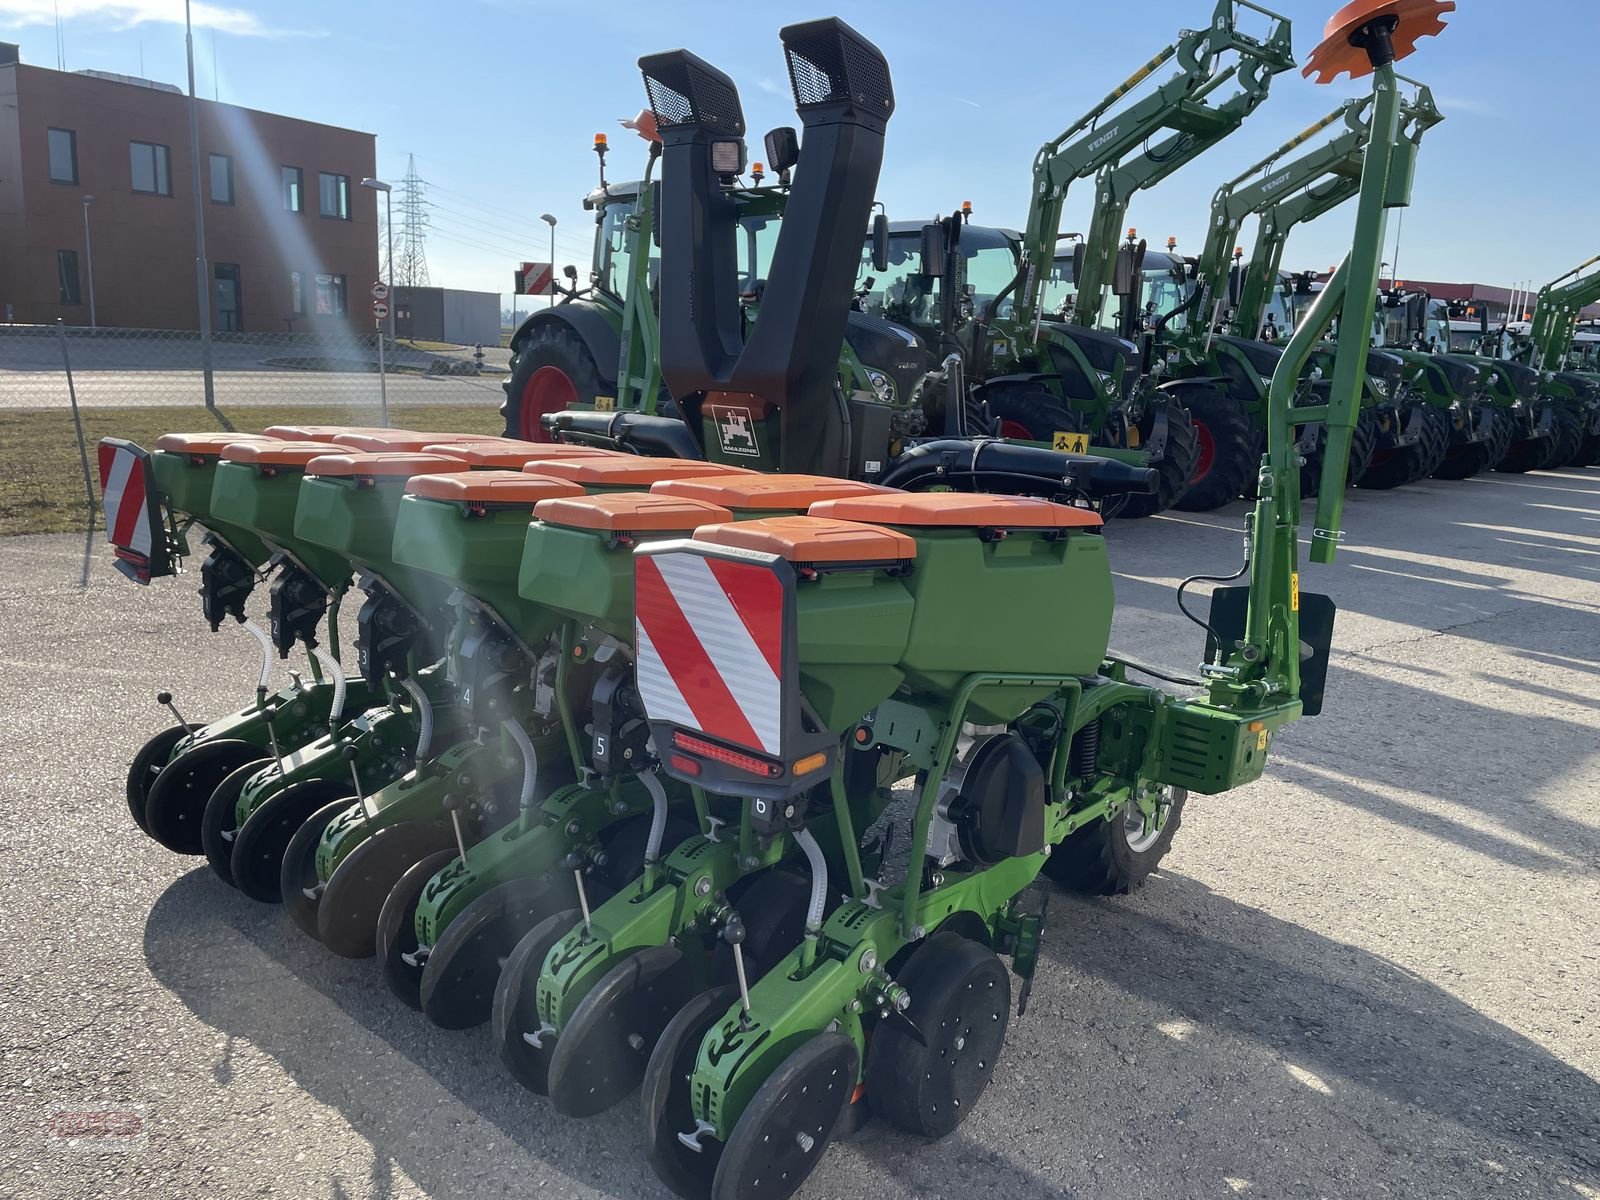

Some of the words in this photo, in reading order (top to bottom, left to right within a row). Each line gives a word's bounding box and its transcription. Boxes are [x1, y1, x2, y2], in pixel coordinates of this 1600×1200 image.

[1087, 125, 1119, 152] FENDT
[1260, 170, 1291, 193] FENDT
[723, 445, 758, 455] AMAZONE
[273, 620, 279, 635] 2
[361, 650, 368, 665] 3
[463, 687, 471, 705] 4
[596, 736, 605, 756] 5
[756, 798, 766, 814] 6
